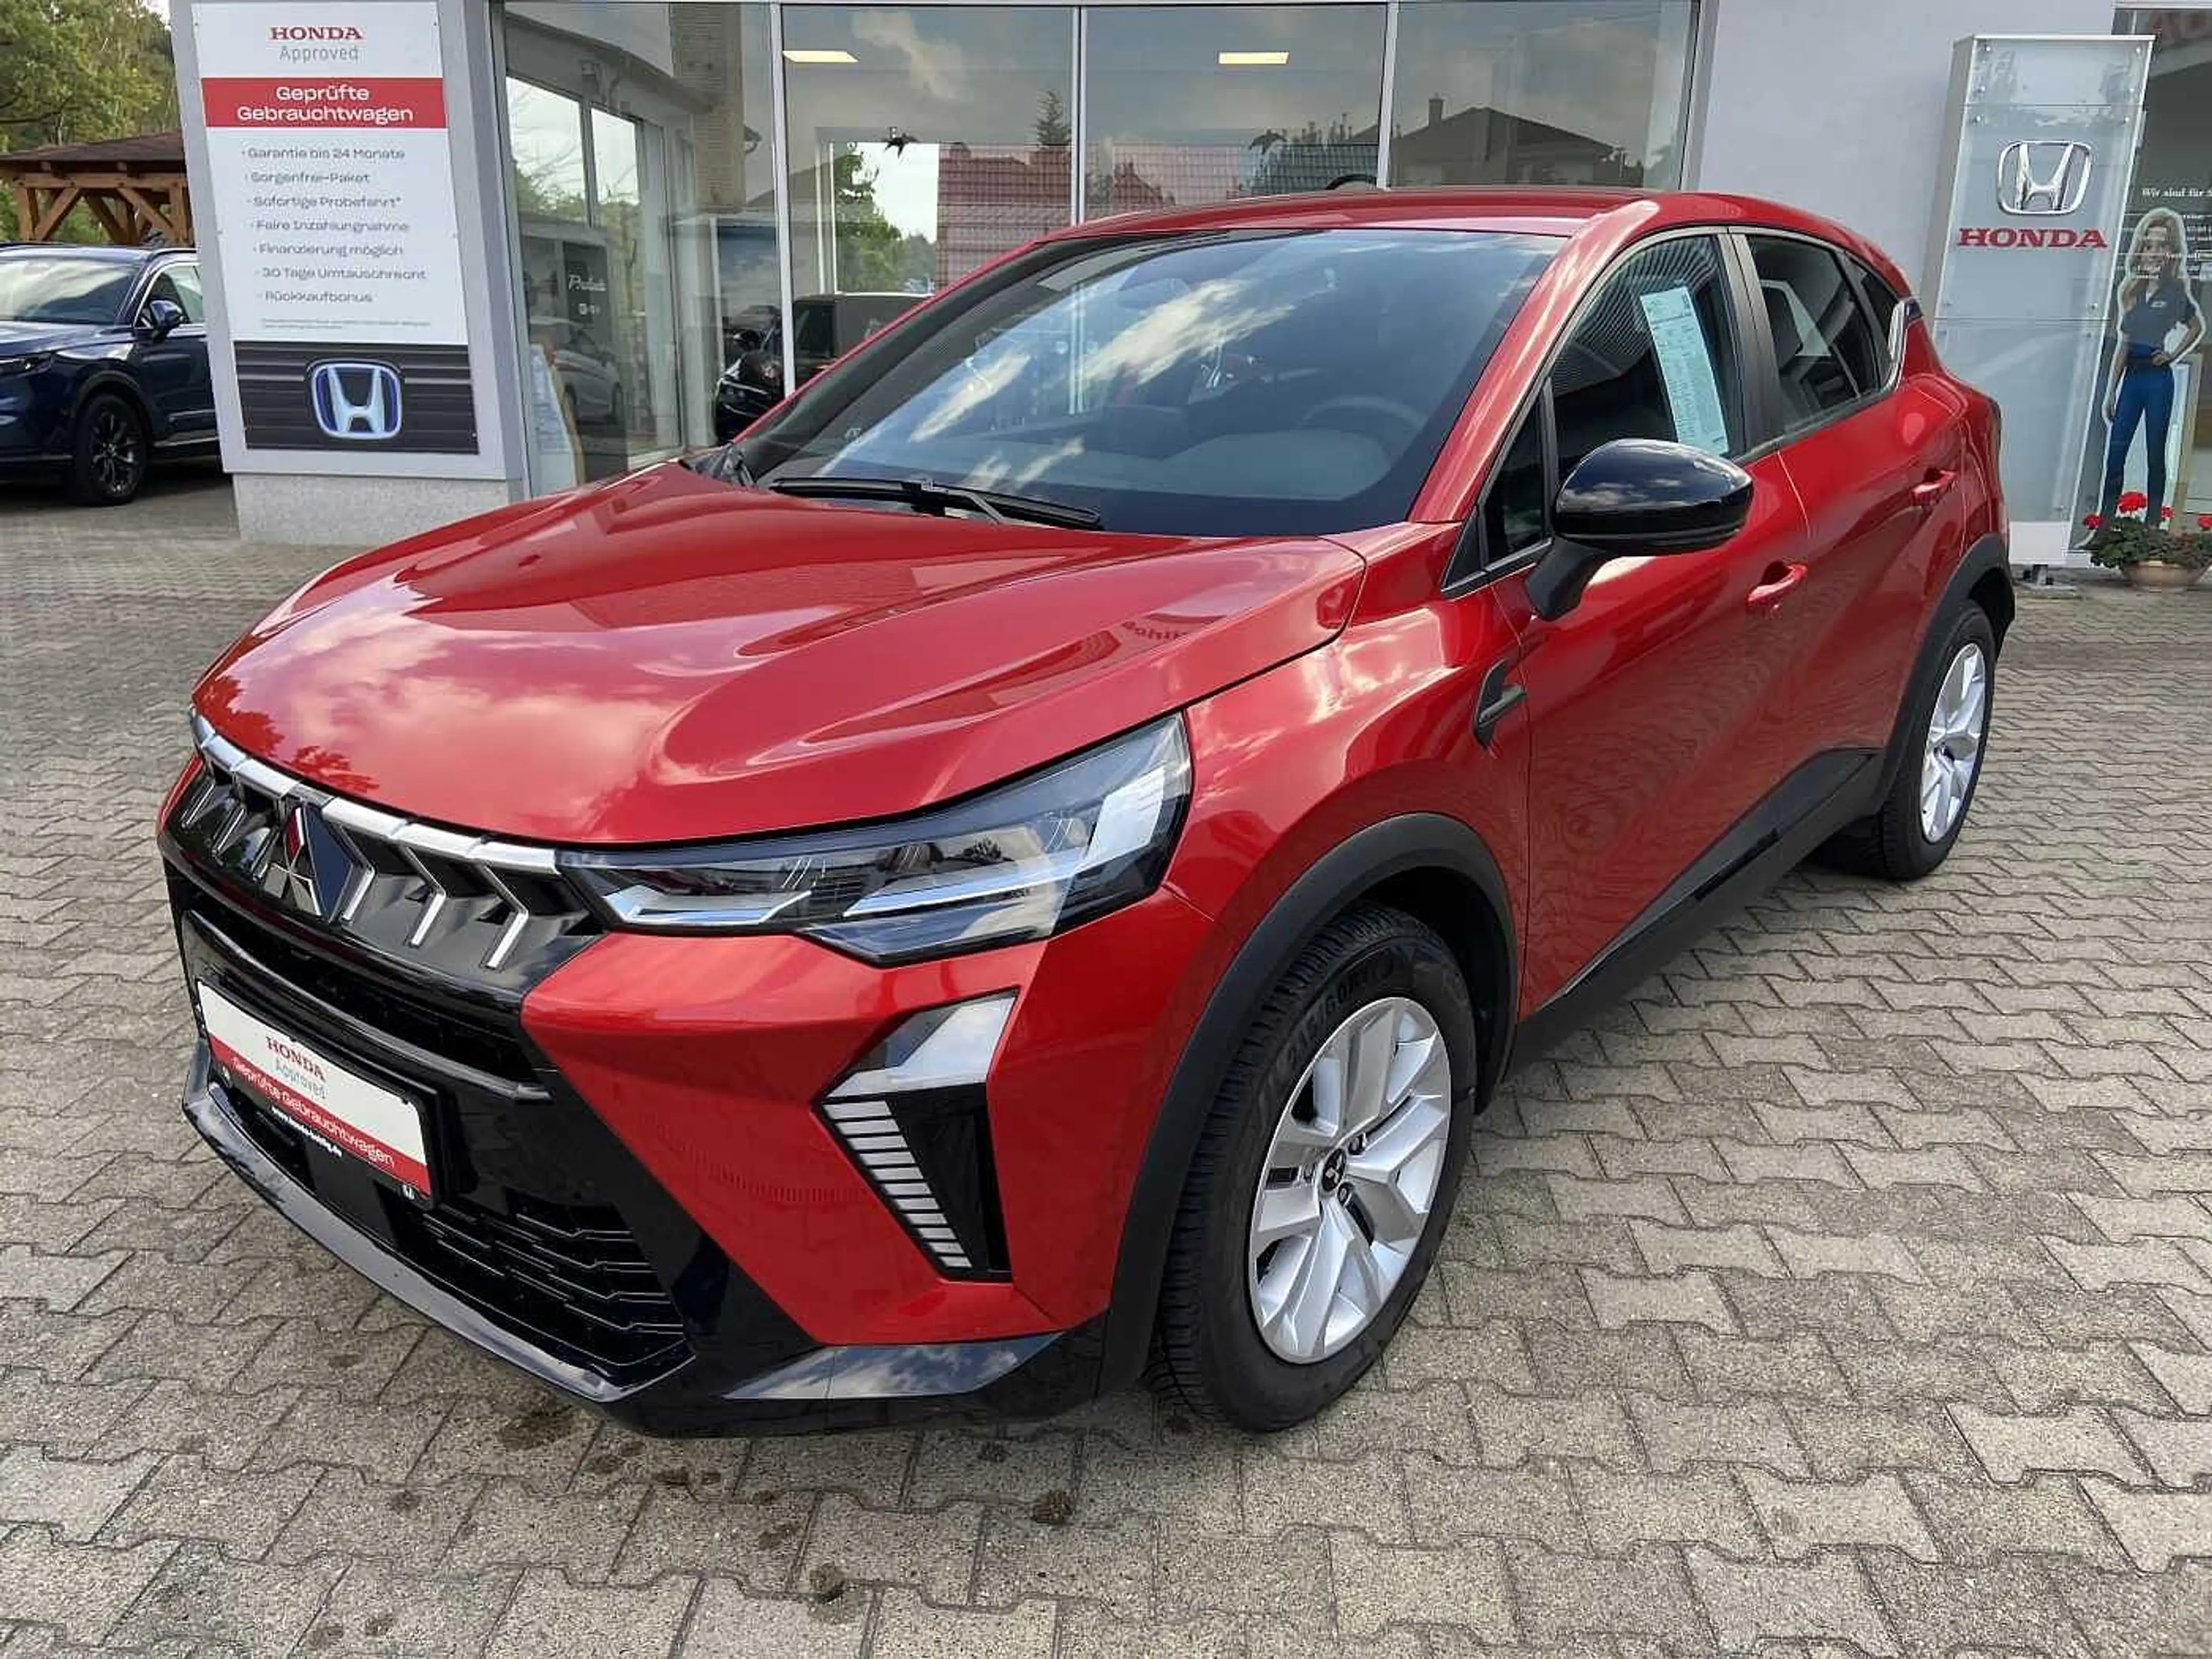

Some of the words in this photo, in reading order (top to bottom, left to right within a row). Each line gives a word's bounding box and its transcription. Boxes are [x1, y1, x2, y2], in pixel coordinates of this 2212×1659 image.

[270, 26, 363, 40] HONDA
[279, 45, 359, 63] Approved
[276, 84, 370, 104] Geprüfte
[237, 105, 414, 125] Gebrauchtwagen
[248, 146, 307, 159] Garantie
[309, 146, 330, 159] bis
[332, 147, 350, 159] 24
[353, 147, 406, 160] Monate
[2142, 187, 2160, 198] Wir
[2189, 187, 2205, 197] für
[253, 196, 317, 210] Sofortige
[256, 219, 290, 231] Faire
[1957, 227, 2108, 248] HONDA
[259, 243, 348, 257] Finanzierung
[349, 244, 404, 258] möglich
[284, 267, 315, 281] Tage
[265, 290, 373, 302] Rückkaufbonus
[266, 1036, 327, 1082] HONDA
